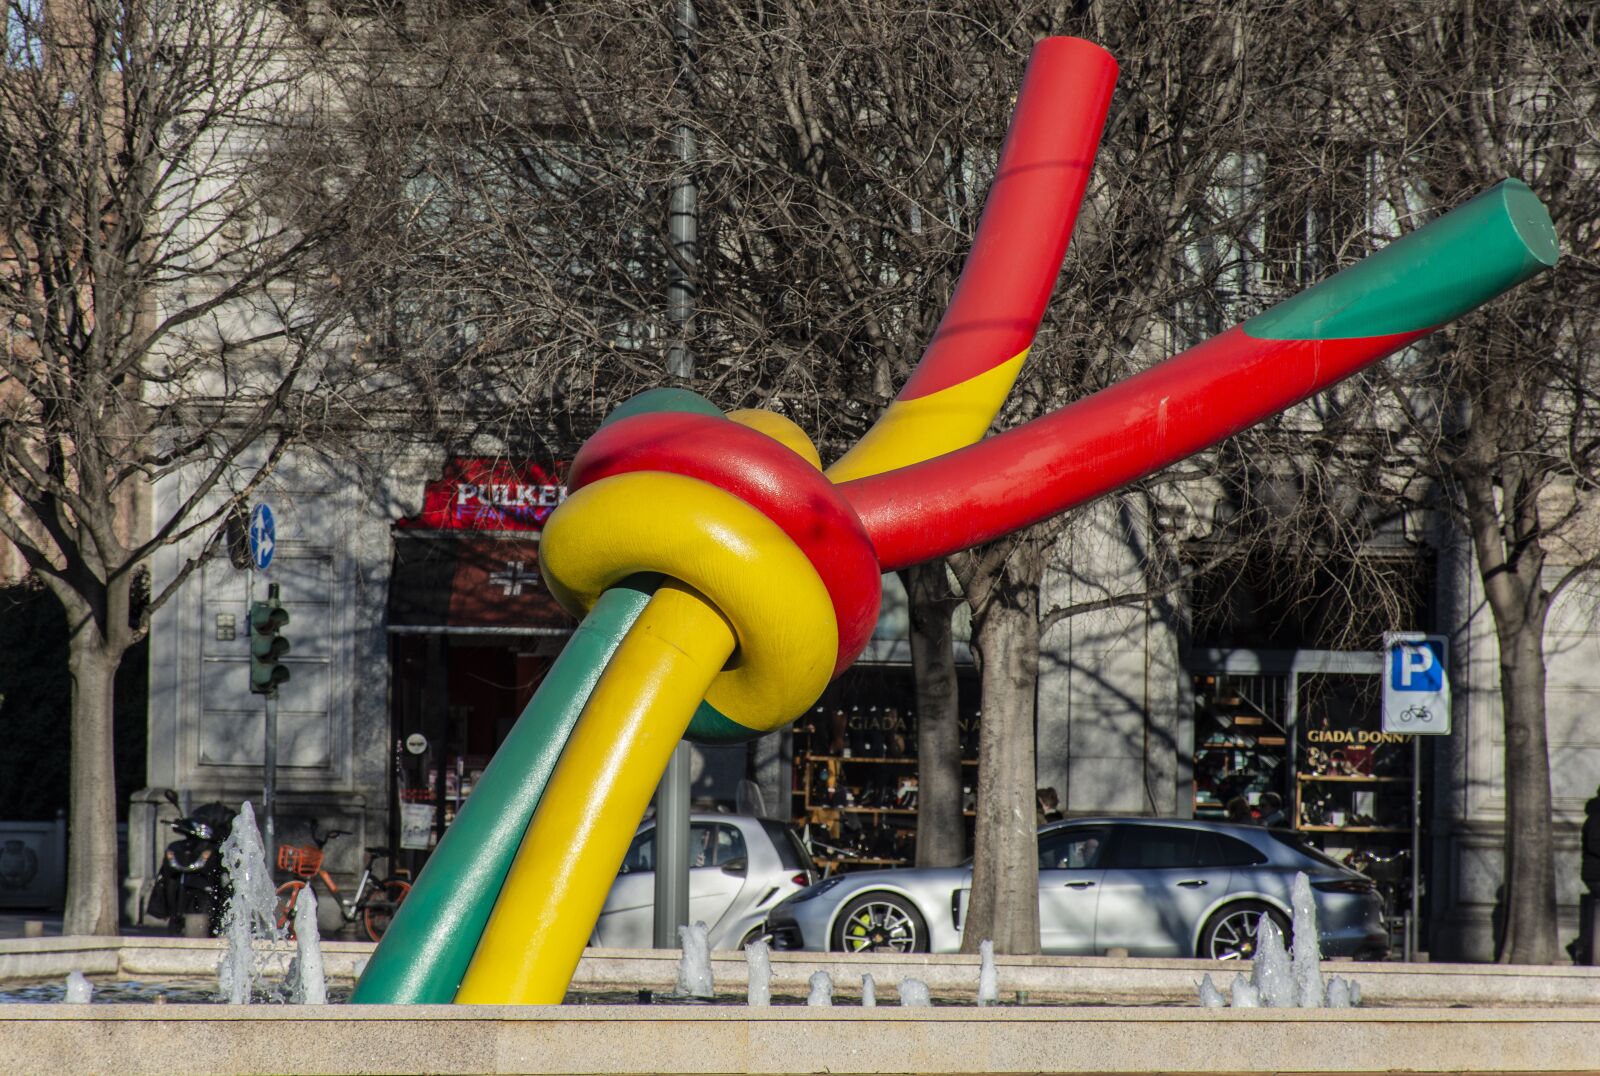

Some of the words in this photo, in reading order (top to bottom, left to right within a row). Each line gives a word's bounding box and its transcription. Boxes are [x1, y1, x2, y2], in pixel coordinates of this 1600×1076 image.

[1402, 646, 1432, 686] P
[848, 716, 906, 731] GIADA
[1307, 730, 1354, 743] GIADA
